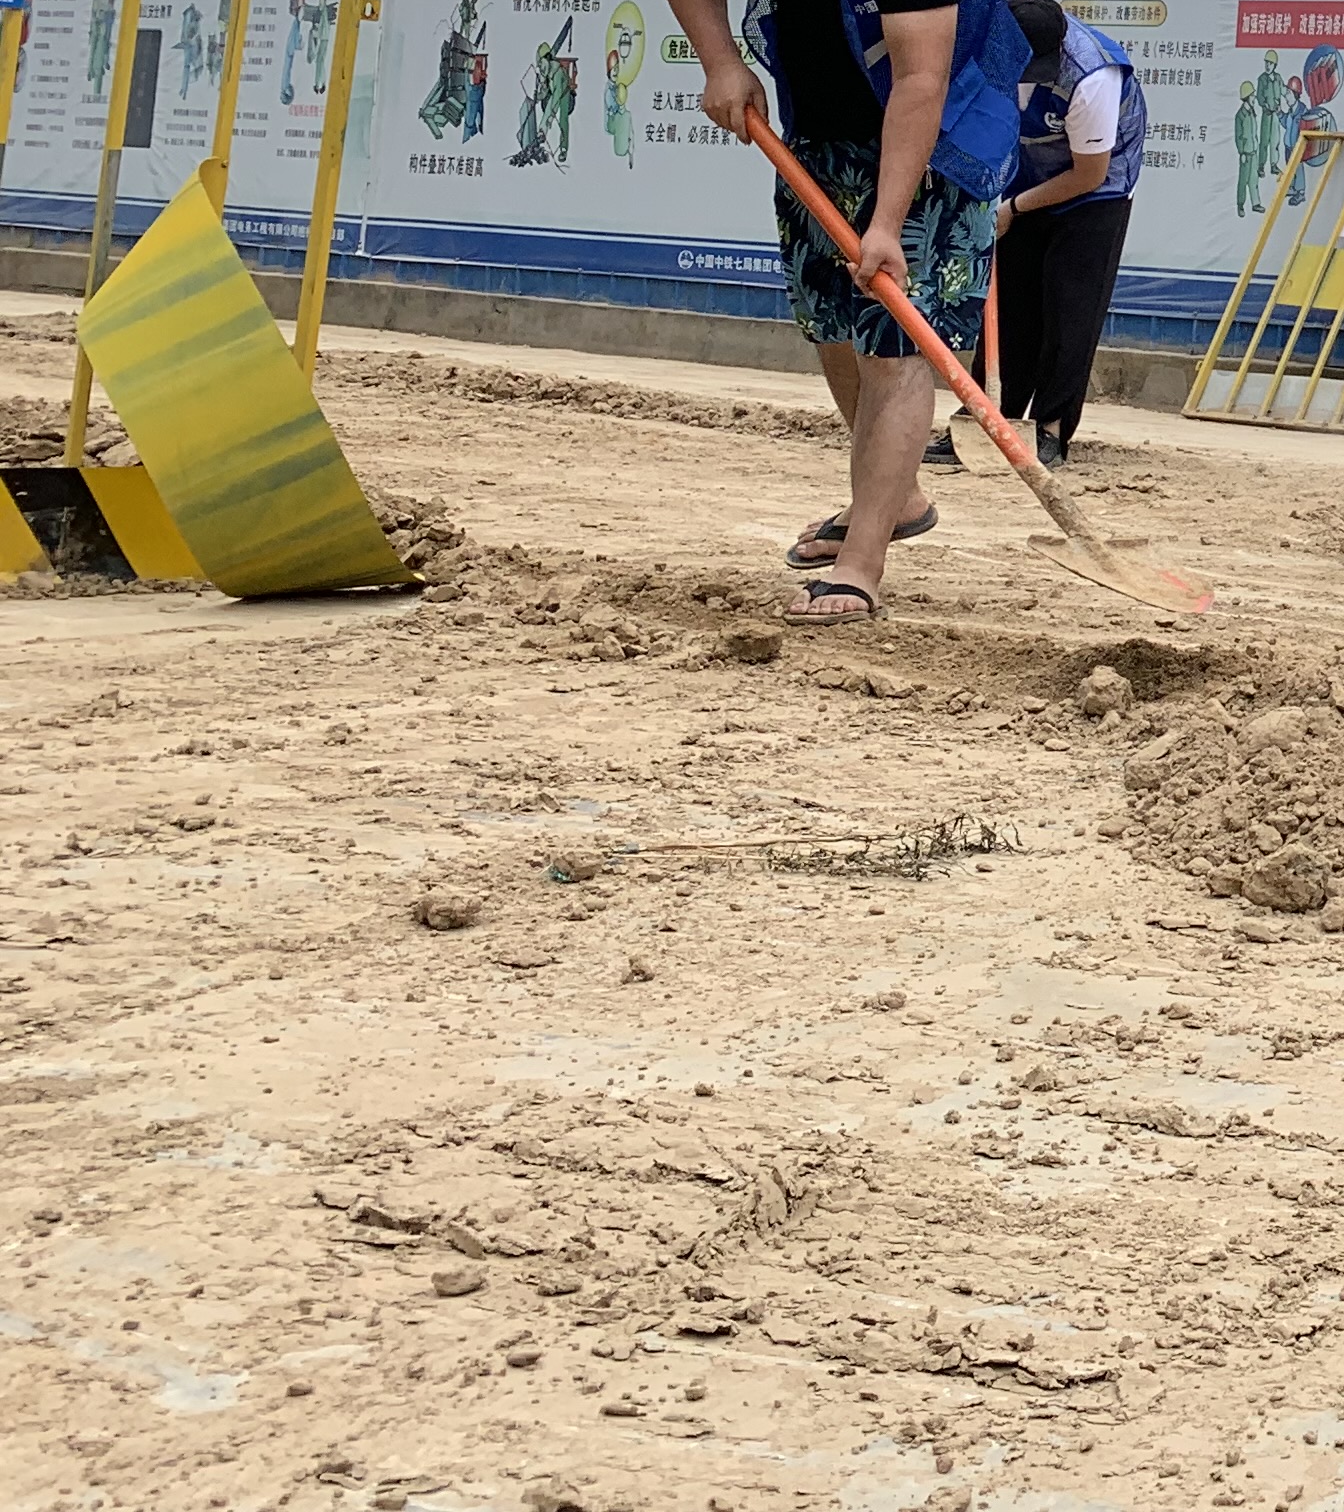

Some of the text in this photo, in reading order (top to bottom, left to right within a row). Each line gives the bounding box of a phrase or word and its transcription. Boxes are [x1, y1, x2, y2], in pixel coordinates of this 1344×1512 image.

[409, 153, 484, 177] 构件叠放不准超高
[695, 253, 786, 274] 中国中铁七局集团电
